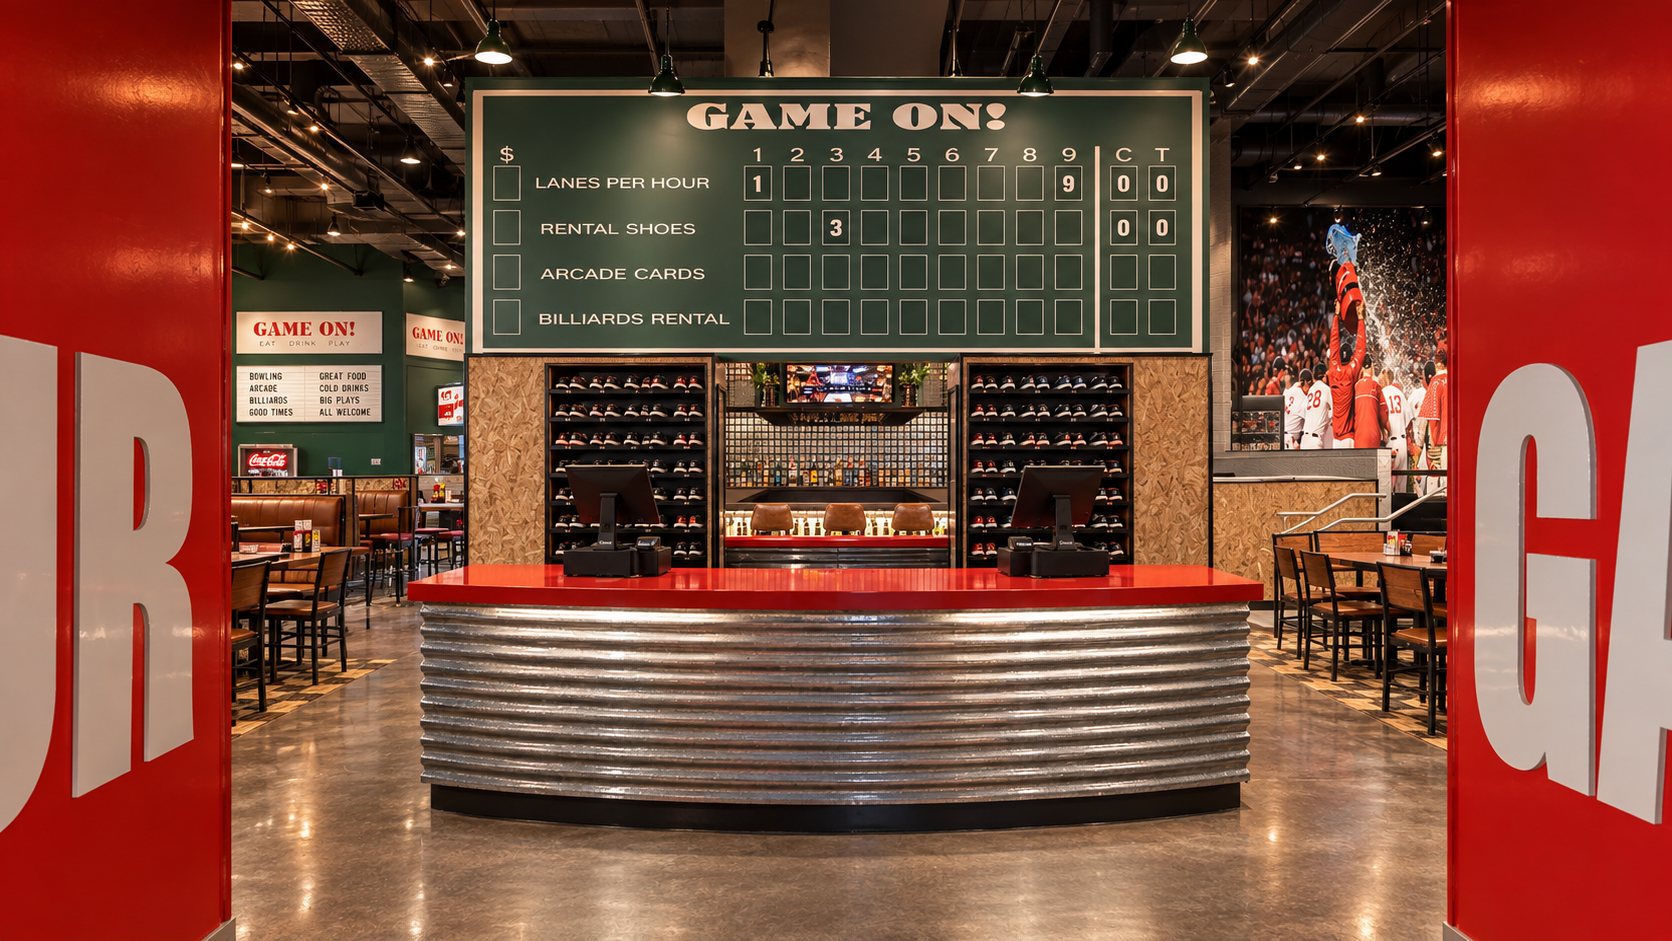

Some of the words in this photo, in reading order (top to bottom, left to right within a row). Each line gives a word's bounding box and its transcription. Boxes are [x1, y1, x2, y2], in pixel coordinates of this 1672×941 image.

[686, 102, 872, 131] GAME
[892, 102, 1007, 131] ON!
[500, 145, 514, 164] $
[753, 147, 761, 162] 1
[790, 147, 805, 162] 2
[830, 147, 844, 162] 3
[867, 147, 883, 162] 4
[907, 147, 921, 162] 5
[945, 147, 960, 162] 6
[984, 147, 999, 162] 7
[1022, 147, 1037, 162] 8
[1061, 147, 1077, 162] 9
[1115, 147, 1132, 162] C
[1154, 147, 1170, 162] T
[535, 177, 601, 189] LANES
[607, 177, 645, 189] PER
[651, 176, 710, 189] HOUR
[753, 175, 761, 193] 1
[1062, 174, 1075, 193] 9
[1117, 174, 1130, 193] 0
[1156, 174, 1169, 193] 0
[541, 223, 620, 235] RENTAL
[626, 223, 696, 235] SHOES
[829, 219, 843, 237] 3
[1117, 219, 1130, 237] 0
[1156, 218, 1169, 237] 0
[540, 268, 627, 280] ARCADE
[634, 268, 705, 280] CARDS
[539, 313, 644, 325] BILLIARDS
[651, 313, 730, 325] RENTAL
[253, 321, 312, 337] GAME
[319, 321, 355, 337] ON!
[412, 326, 443, 342] GAME
[445, 331, 464, 345] ON!
[249, 372, 283, 381] BOWLING
[319, 371, 344, 381] GREAT
[347, 371, 367, 381] FOOD
[249, 384, 278, 393] ARCADE
[319, 384, 339, 393] COLD
[249, 396, 288, 405] BILLIARDS
[319, 396, 333, 405] BIG
[336, 395, 360, 405] PLAYS
[1306, 389, 1322, 411] 28
[1388, 395, 1402, 414] 13
[249, 407, 268, 417] GOOD
[271, 408, 294, 417] TIMES
[319, 408, 333, 417] ALL
[336, 407, 371, 417] WELCOME
